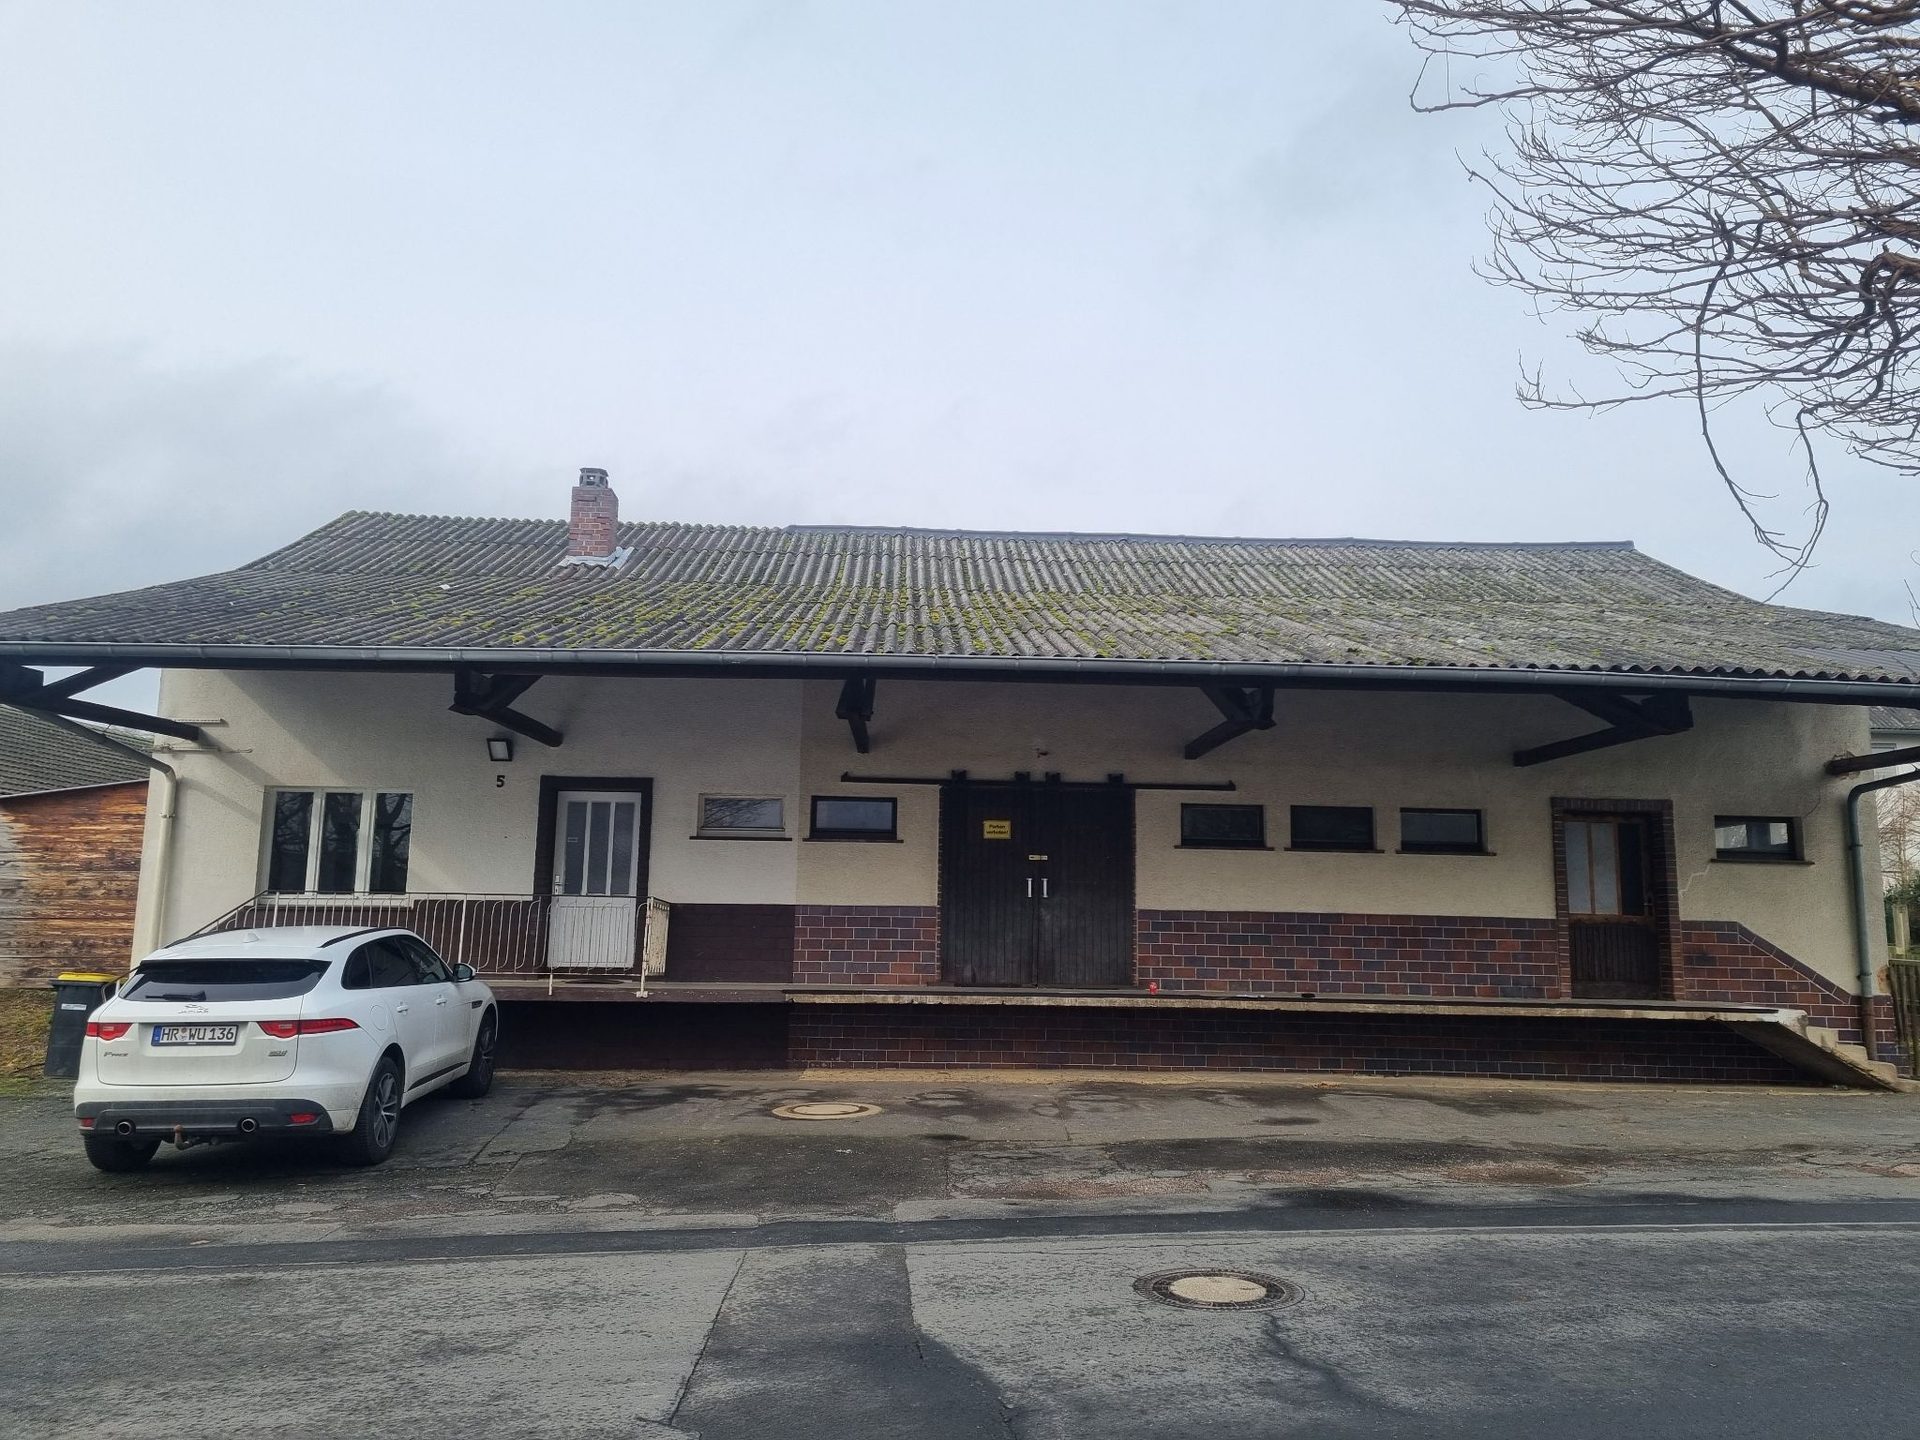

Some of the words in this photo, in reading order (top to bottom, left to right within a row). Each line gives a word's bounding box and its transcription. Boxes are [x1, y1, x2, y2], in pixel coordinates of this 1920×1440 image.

[496, 775, 506, 788] 5
[160, 1028, 180, 1041] HR
[188, 1027, 207, 1041] WU
[208, 1027, 234, 1041] 136
